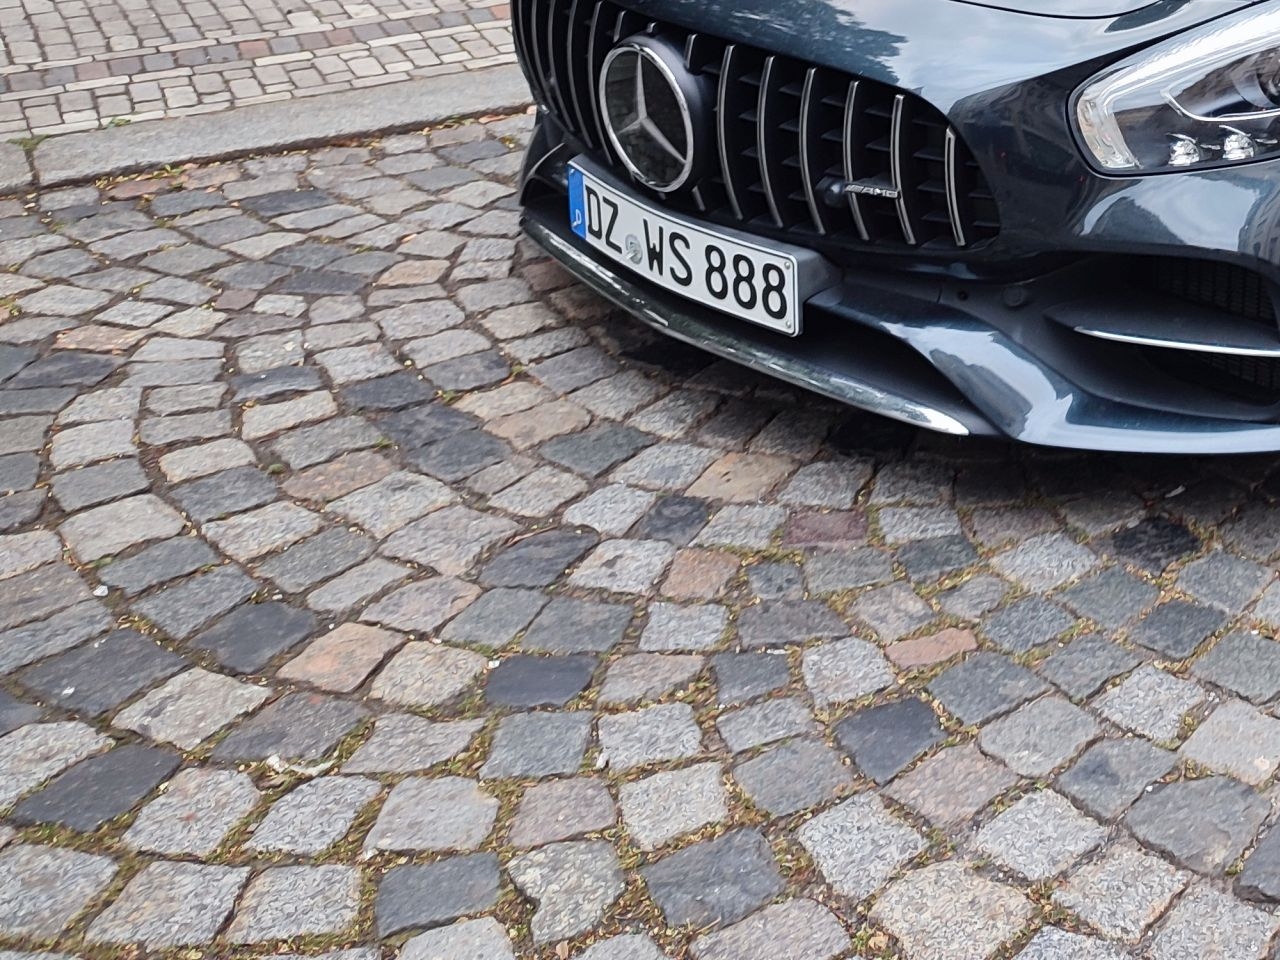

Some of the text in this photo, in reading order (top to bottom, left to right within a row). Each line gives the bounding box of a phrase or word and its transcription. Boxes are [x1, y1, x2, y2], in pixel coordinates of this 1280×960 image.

[575, 208, 582, 225] D
[585, 184, 788, 319] DZ WS 888
